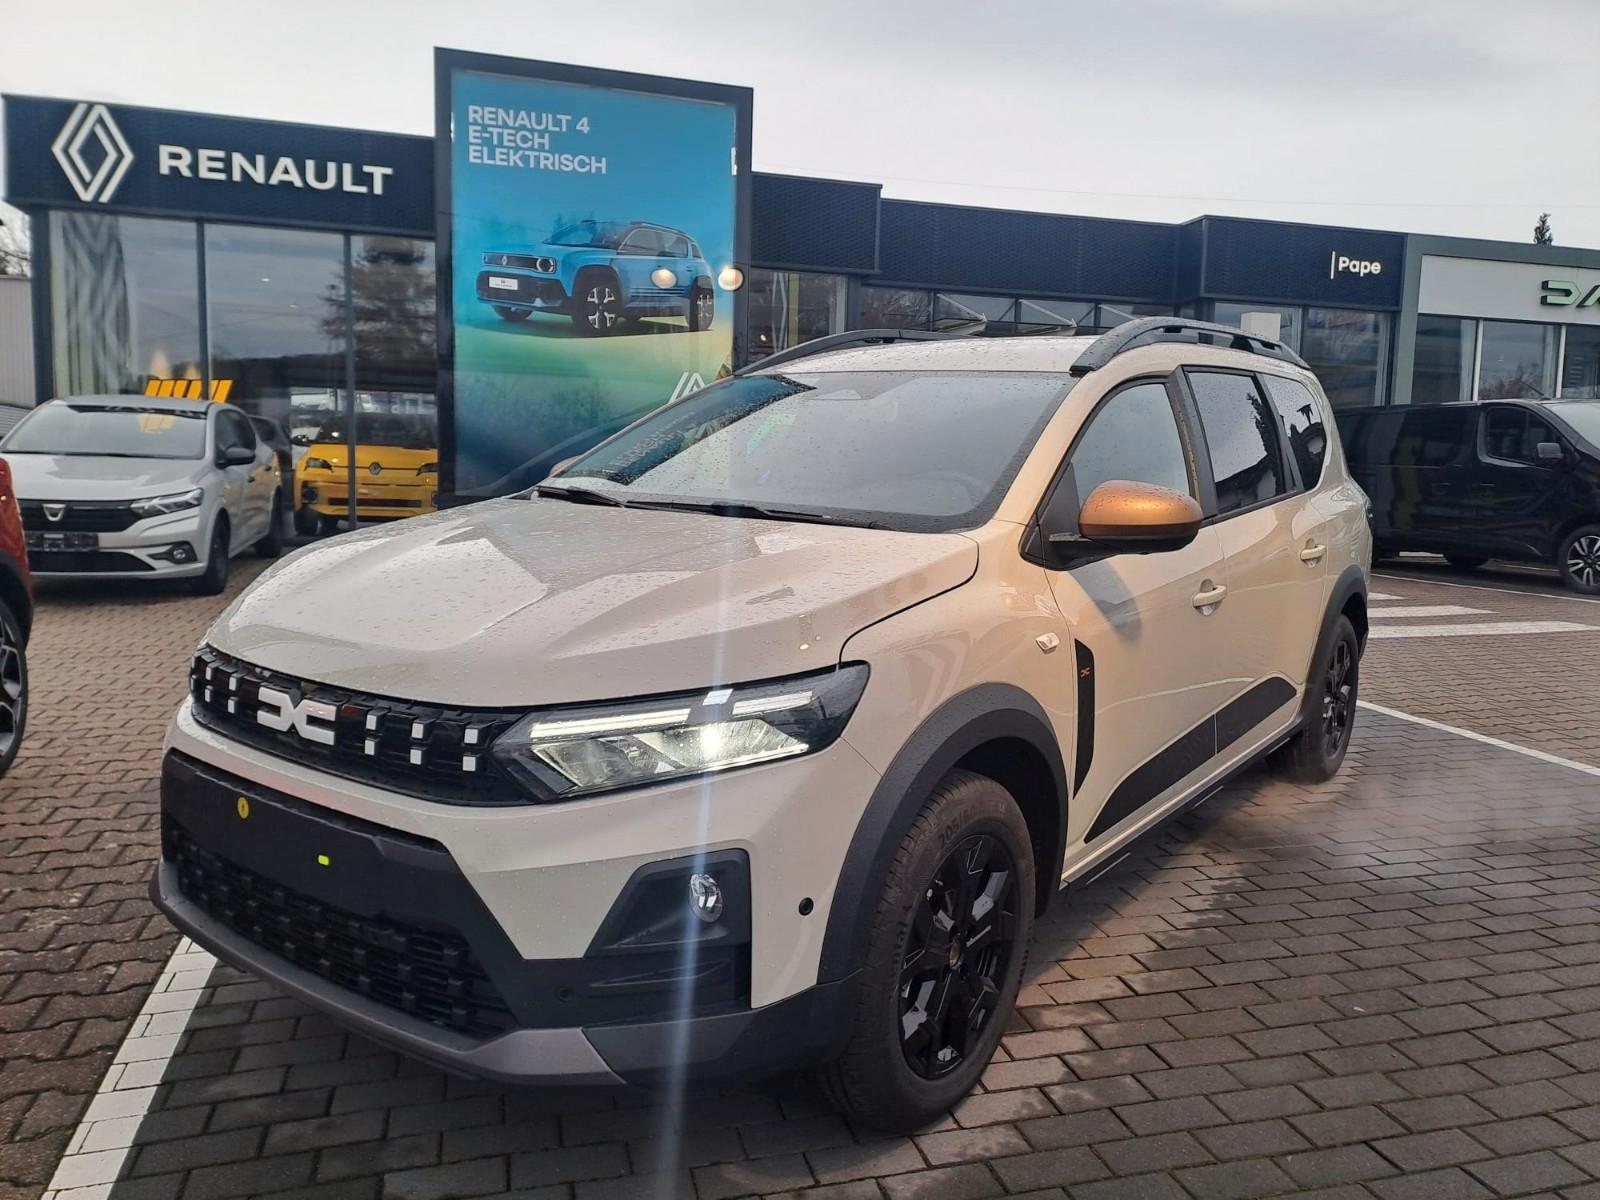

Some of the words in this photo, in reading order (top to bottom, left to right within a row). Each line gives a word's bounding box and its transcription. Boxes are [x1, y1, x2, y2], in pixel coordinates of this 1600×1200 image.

[468, 105, 572, 132] RENAULT
[575, 117, 590, 134] 4
[468, 125, 550, 150] E-TECH
[158, 144, 394, 195] RENAULT
[468, 145, 607, 174] ELEKTRISCH
[1338, 256, 1381, 277] Pape
